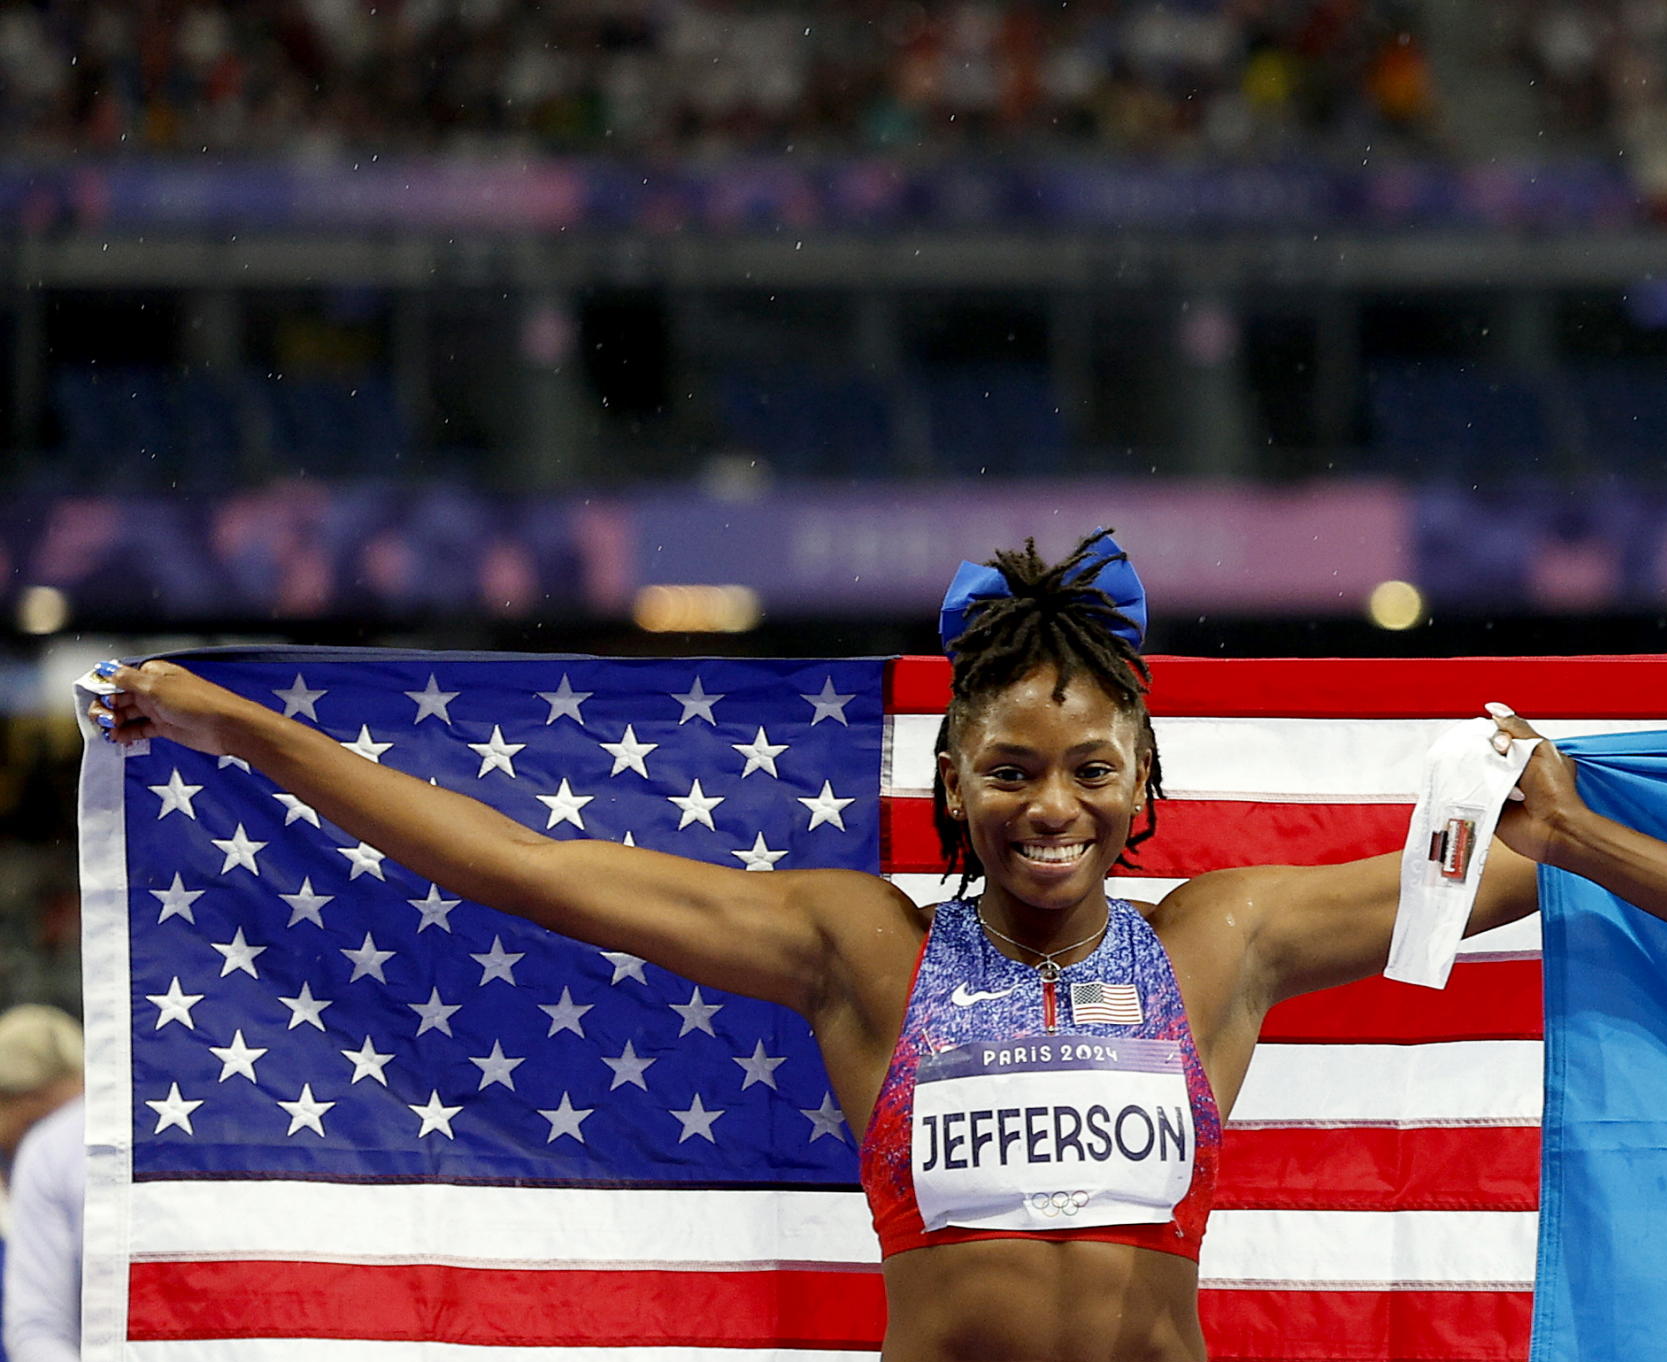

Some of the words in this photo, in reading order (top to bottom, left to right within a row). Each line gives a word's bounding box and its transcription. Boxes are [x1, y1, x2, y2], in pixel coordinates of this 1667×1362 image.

[983, 1045, 1052, 1066] PARIS
[1060, 1044, 1119, 1061] 2024
[922, 1104, 1186, 1172] JEFFERSON
